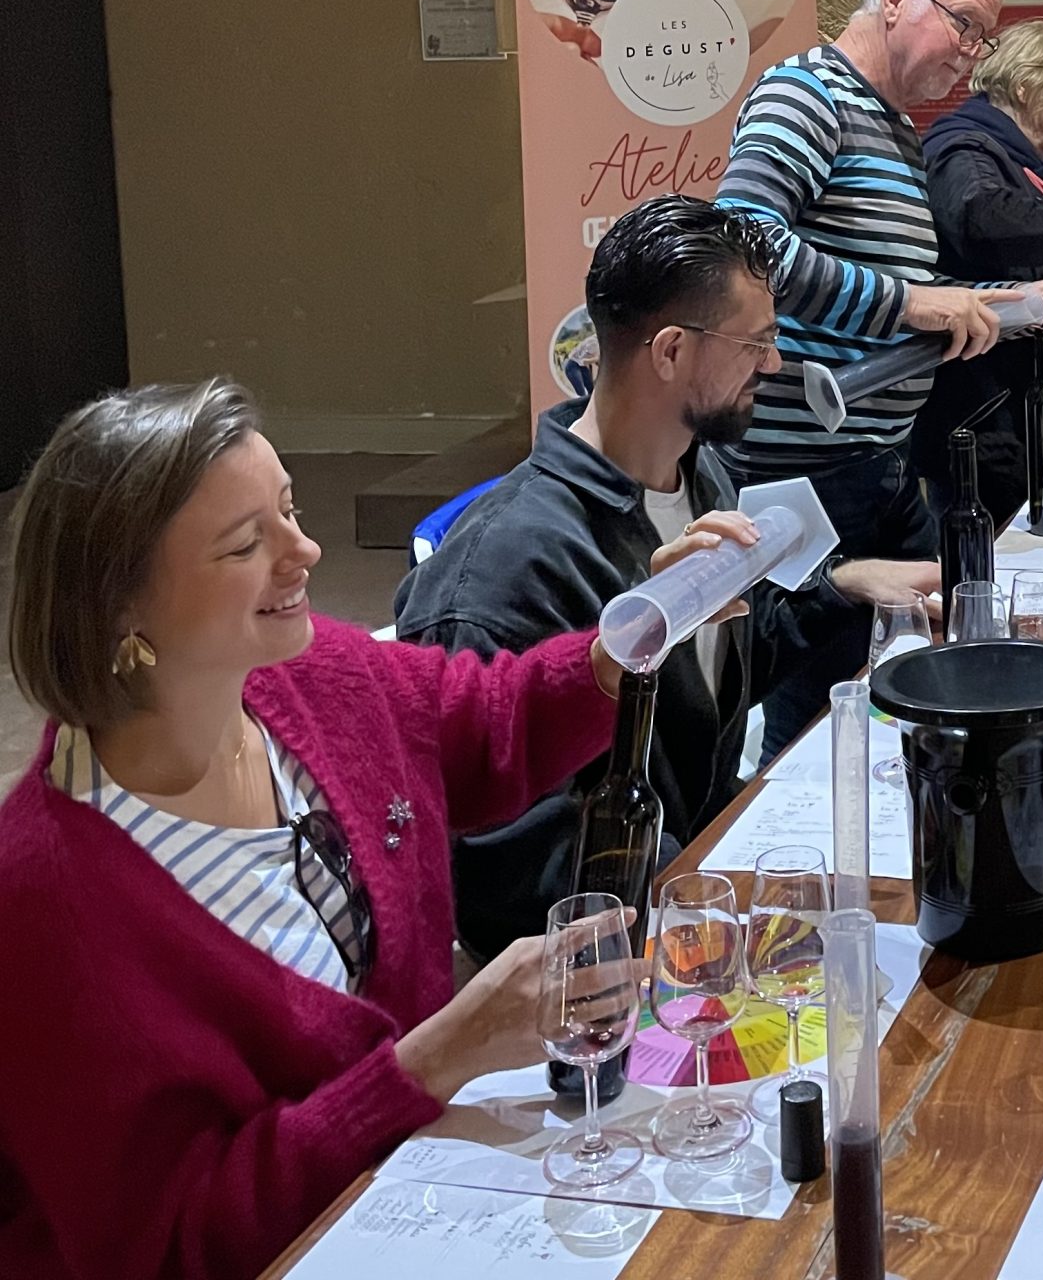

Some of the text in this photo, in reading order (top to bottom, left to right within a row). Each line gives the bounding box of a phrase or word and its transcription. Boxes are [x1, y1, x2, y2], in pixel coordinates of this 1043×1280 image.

[661, 20, 687, 30] LES
[644, 63, 698, 88] de Lisa
[580, 129, 729, 207] Atelie
